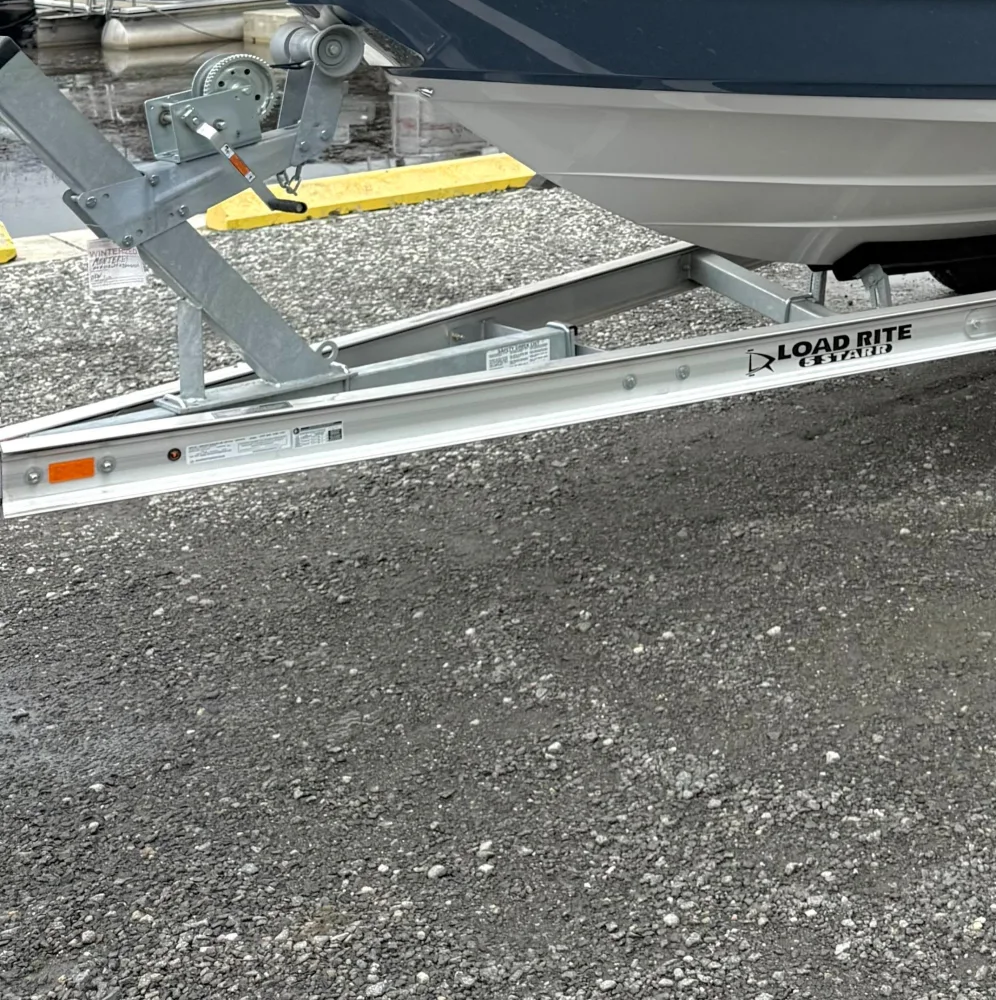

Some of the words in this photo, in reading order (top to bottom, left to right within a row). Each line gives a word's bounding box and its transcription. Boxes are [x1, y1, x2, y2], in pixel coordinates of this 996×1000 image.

[778, 334, 850, 360] LOAD
[857, 324, 912, 347] RITE
[804, 356, 816, 367] 5
[821, 344, 889, 362] STARR
